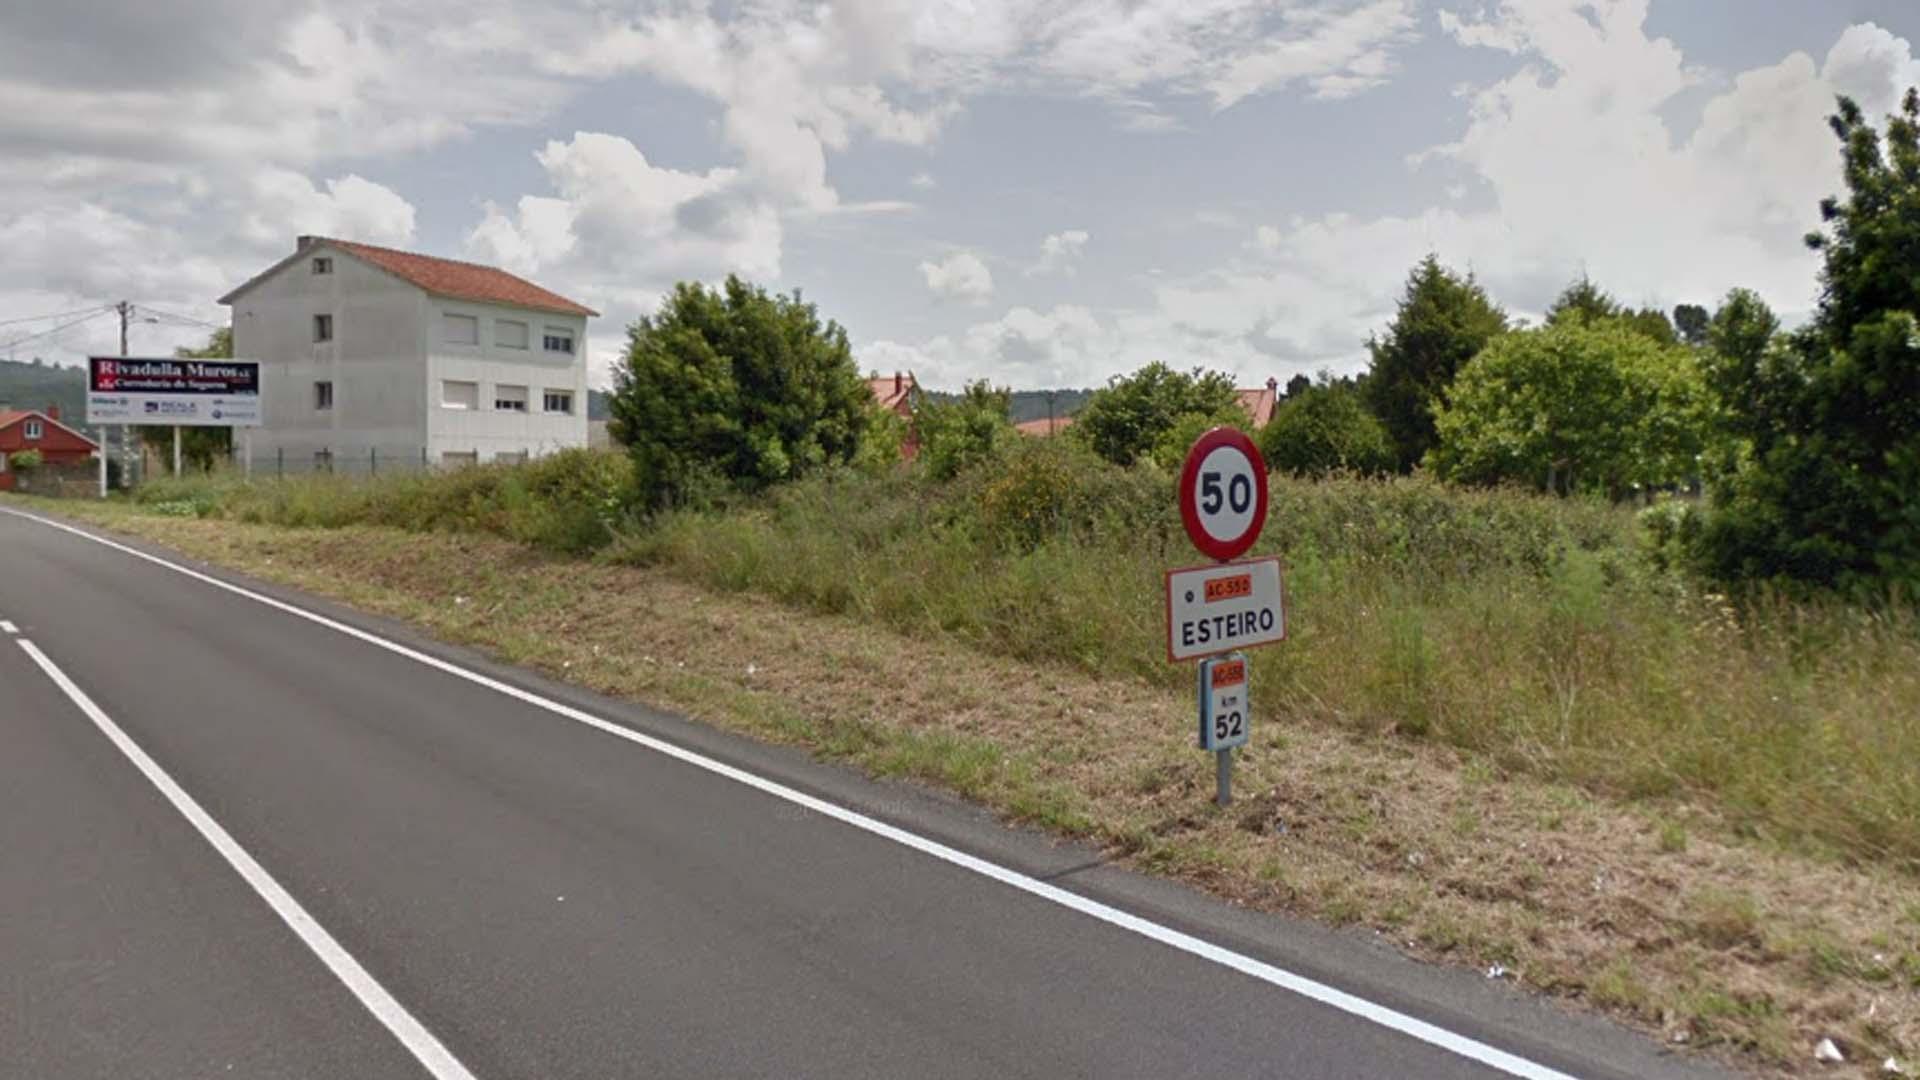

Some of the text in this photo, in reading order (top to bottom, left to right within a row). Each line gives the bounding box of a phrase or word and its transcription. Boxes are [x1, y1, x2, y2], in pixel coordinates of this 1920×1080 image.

[187, 363, 236, 378] Muros
[1202, 472, 1251, 515] 50
[1182, 608, 1274, 646] ESTEIRO
[1215, 711, 1242, 739] 52
